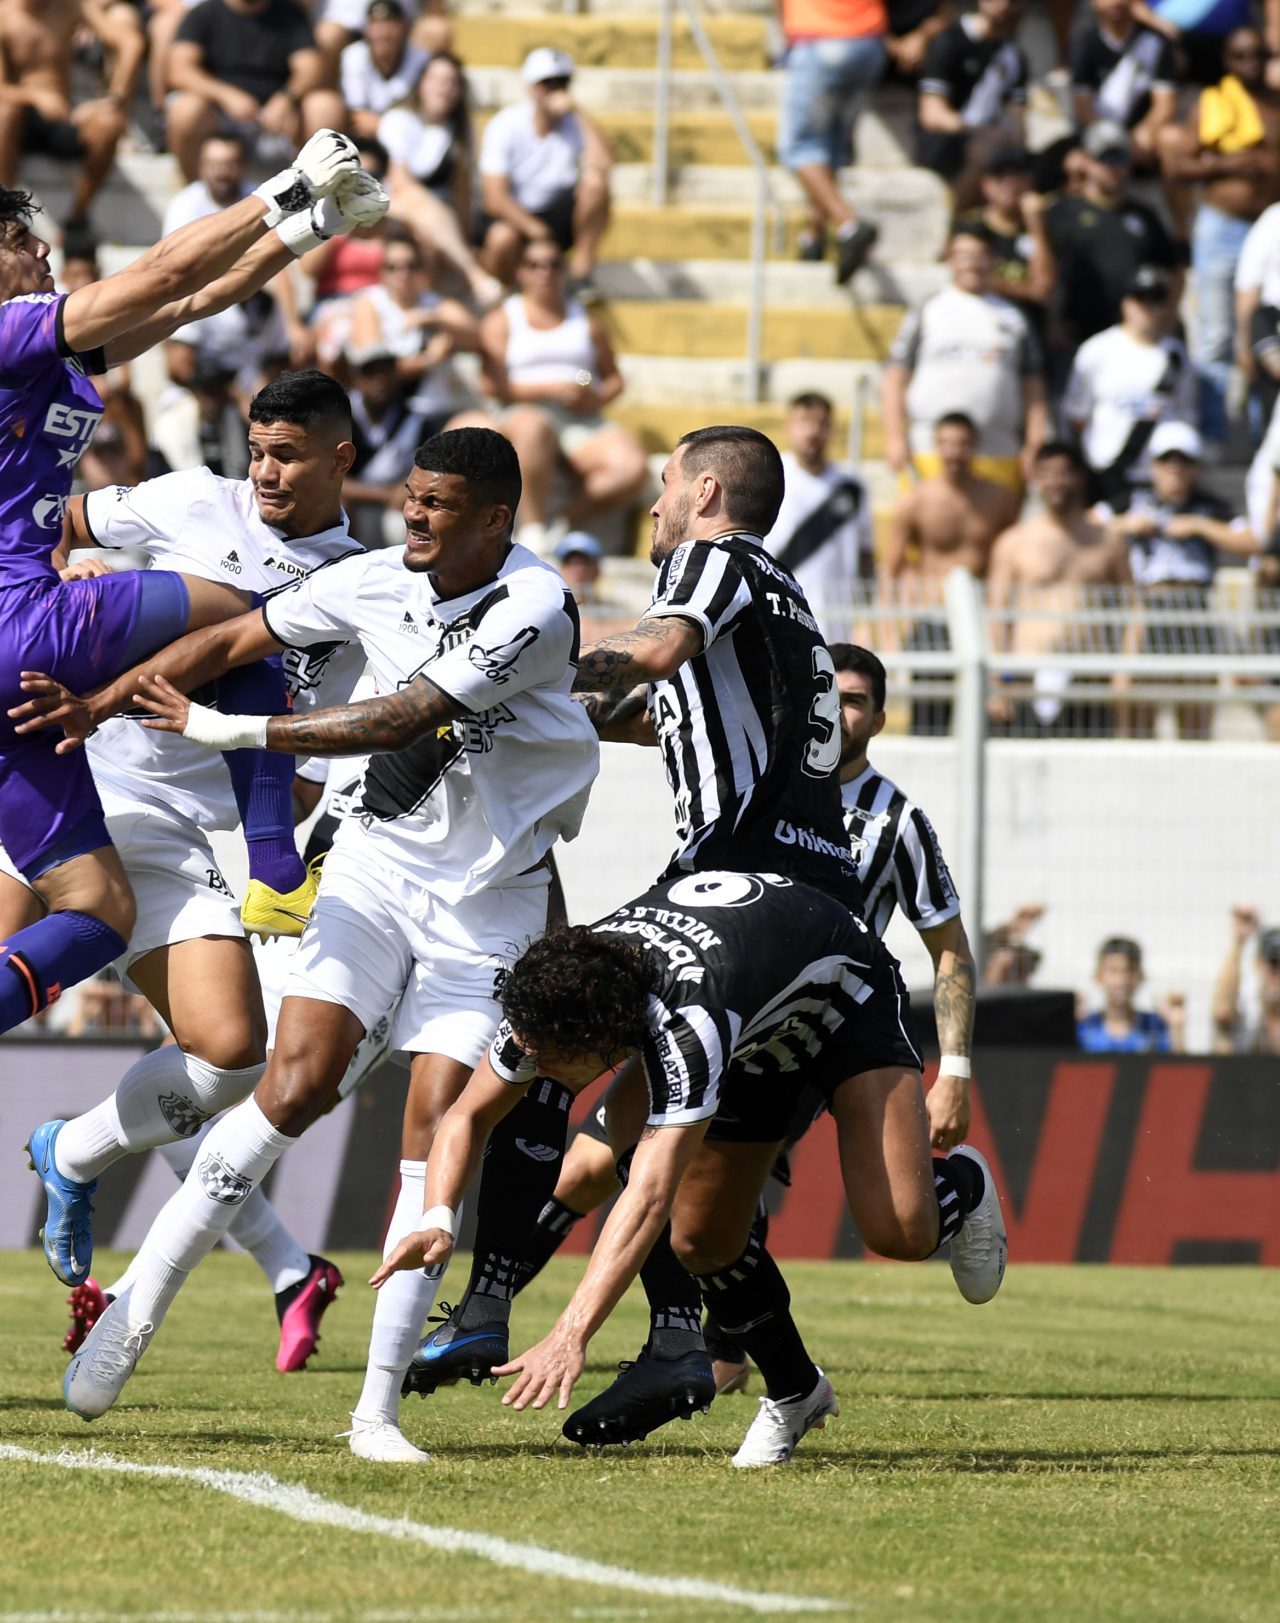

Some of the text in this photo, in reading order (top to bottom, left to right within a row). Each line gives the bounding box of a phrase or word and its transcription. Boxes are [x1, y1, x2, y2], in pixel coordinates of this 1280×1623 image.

[220, 559, 242, 575] 1900
[801, 645, 842, 779] 3
[667, 870, 794, 908] 6
